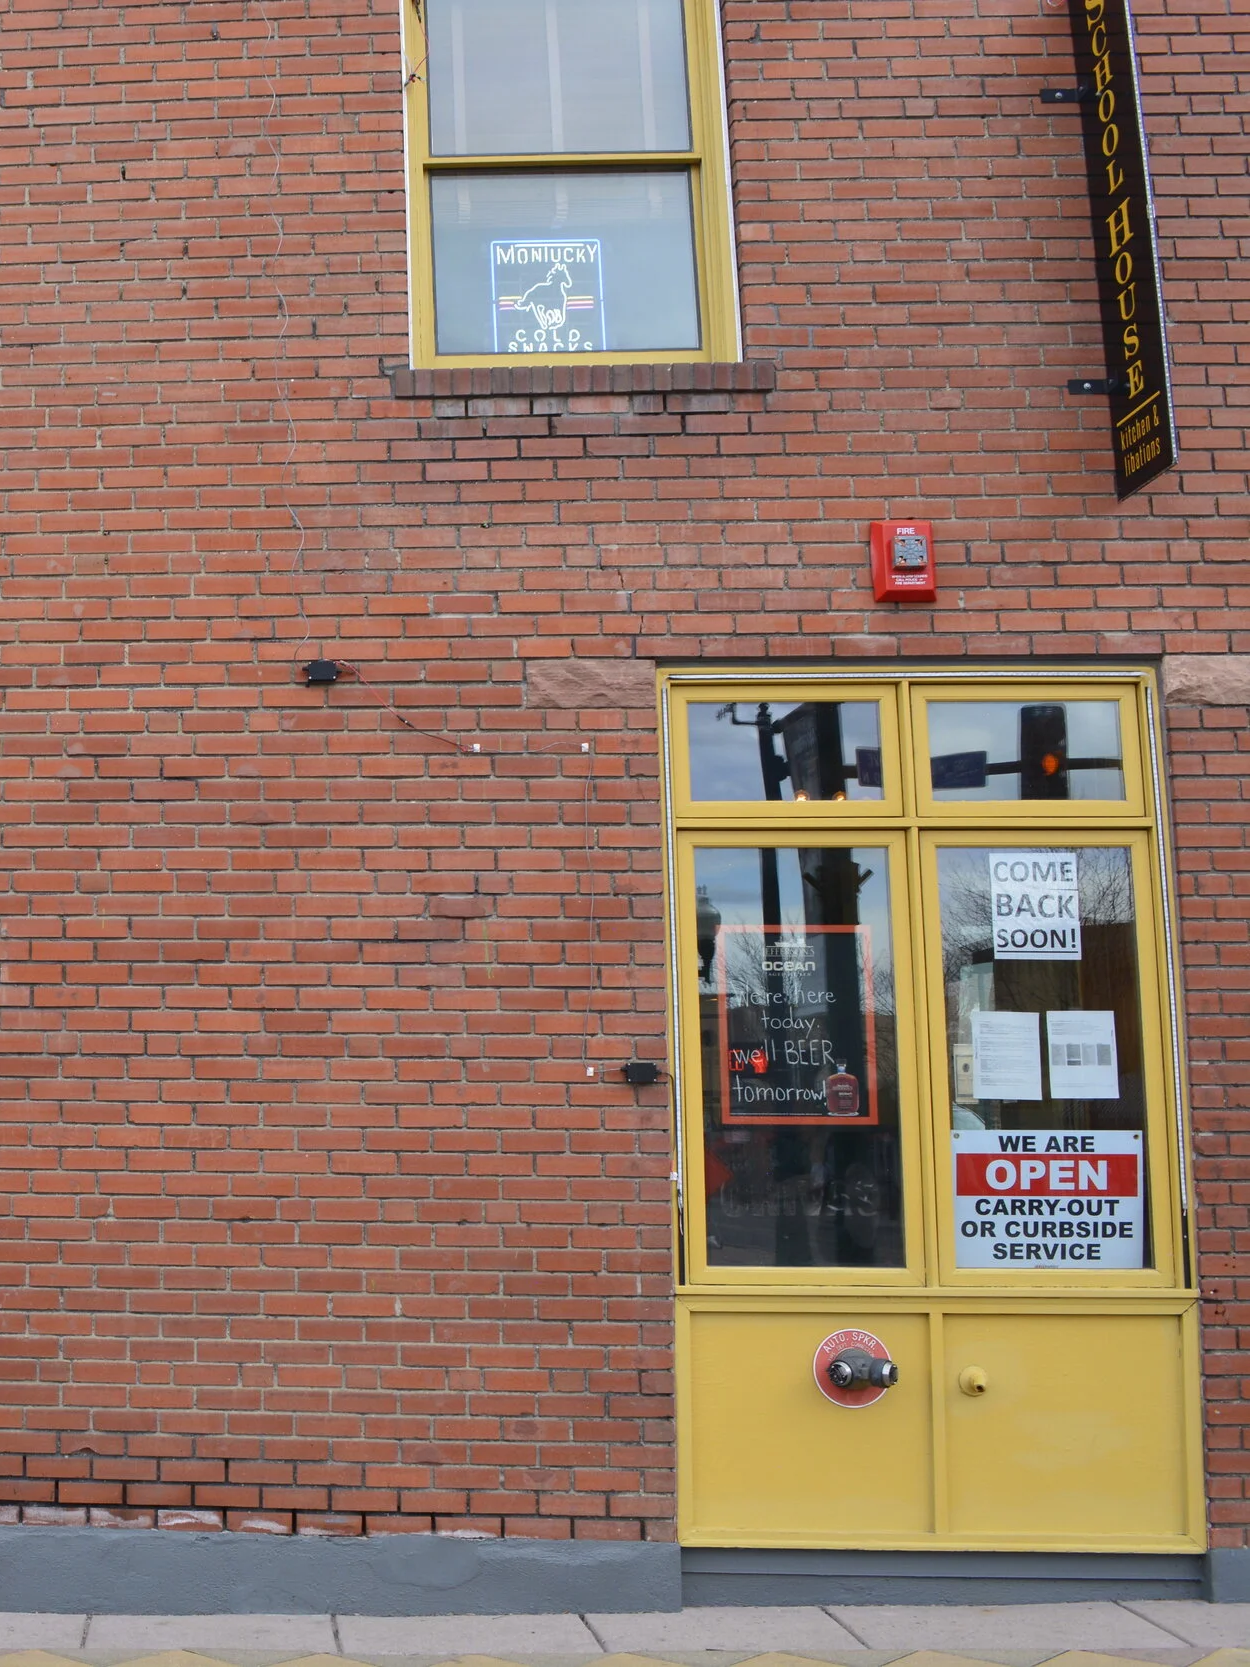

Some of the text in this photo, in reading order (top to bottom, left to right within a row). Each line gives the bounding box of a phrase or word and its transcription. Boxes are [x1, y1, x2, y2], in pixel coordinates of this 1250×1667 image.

[1085, 0, 1145, 400] SCHOOL HOUSE
[515, 329, 581, 342] COLD
[1120, 404, 1160, 451] kitchen &
[1124, 437, 1161, 478] libations
[896, 527, 915, 535] FIRE
[993, 861, 1074, 883] COME
[996, 893, 1075, 919] BACK
[996, 928, 1077, 949] SOON!
[794, 981, 837, 1005] here
[784, 1039, 835, 1066] BEER
[998, 1136, 1095, 1153] WE ARE
[985, 1159, 1108, 1191] OPEN
[975, 1198, 1120, 1216] CARRY-OUT
[961, 1220, 1133, 1239] OR CURBSIDE
[992, 1243, 1101, 1261] SERVICE
